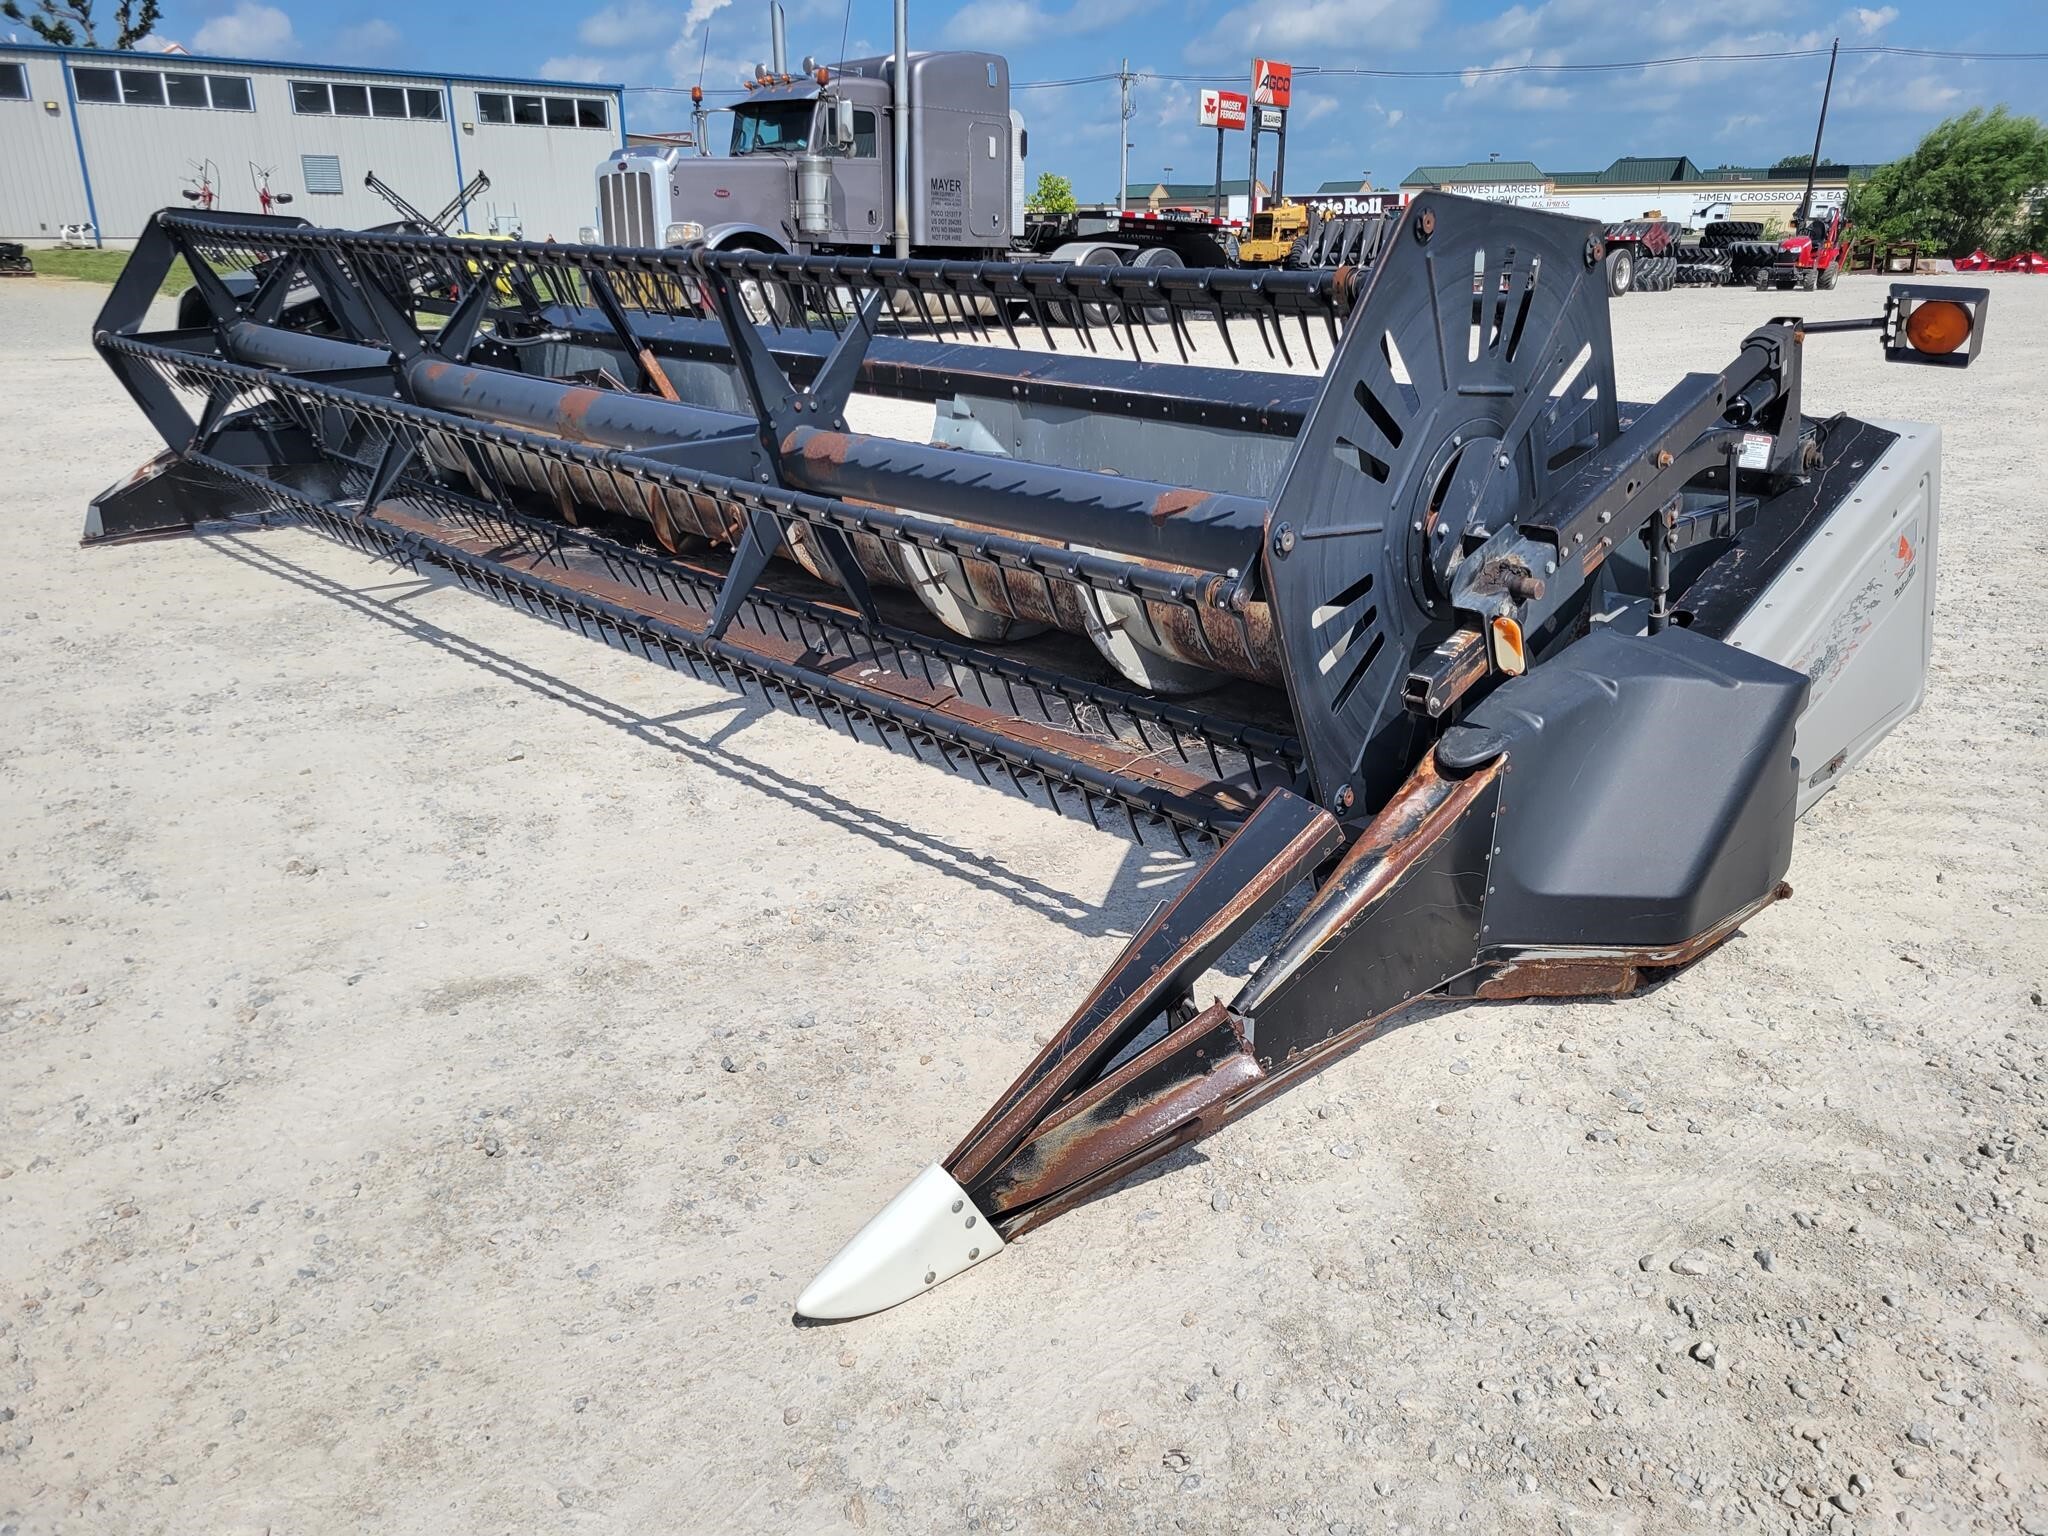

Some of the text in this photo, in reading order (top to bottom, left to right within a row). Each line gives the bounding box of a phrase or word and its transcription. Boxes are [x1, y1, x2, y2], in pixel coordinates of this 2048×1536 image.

[1259, 74, 1290, 91] AGCO
[1220, 100, 1242, 111] MASSEY
[1220, 110, 1245, 121] FERGUSON
[931, 178, 961, 192] MAYER
[1452, 184, 1542, 194] MIDWEST LARGEST
[673, 186, 679, 196] 5
[1692, 193, 1731, 201] HMEN
[1740, 192, 1818, 201] CROSSROAS
[1344, 197, 1382, 214] Roll
